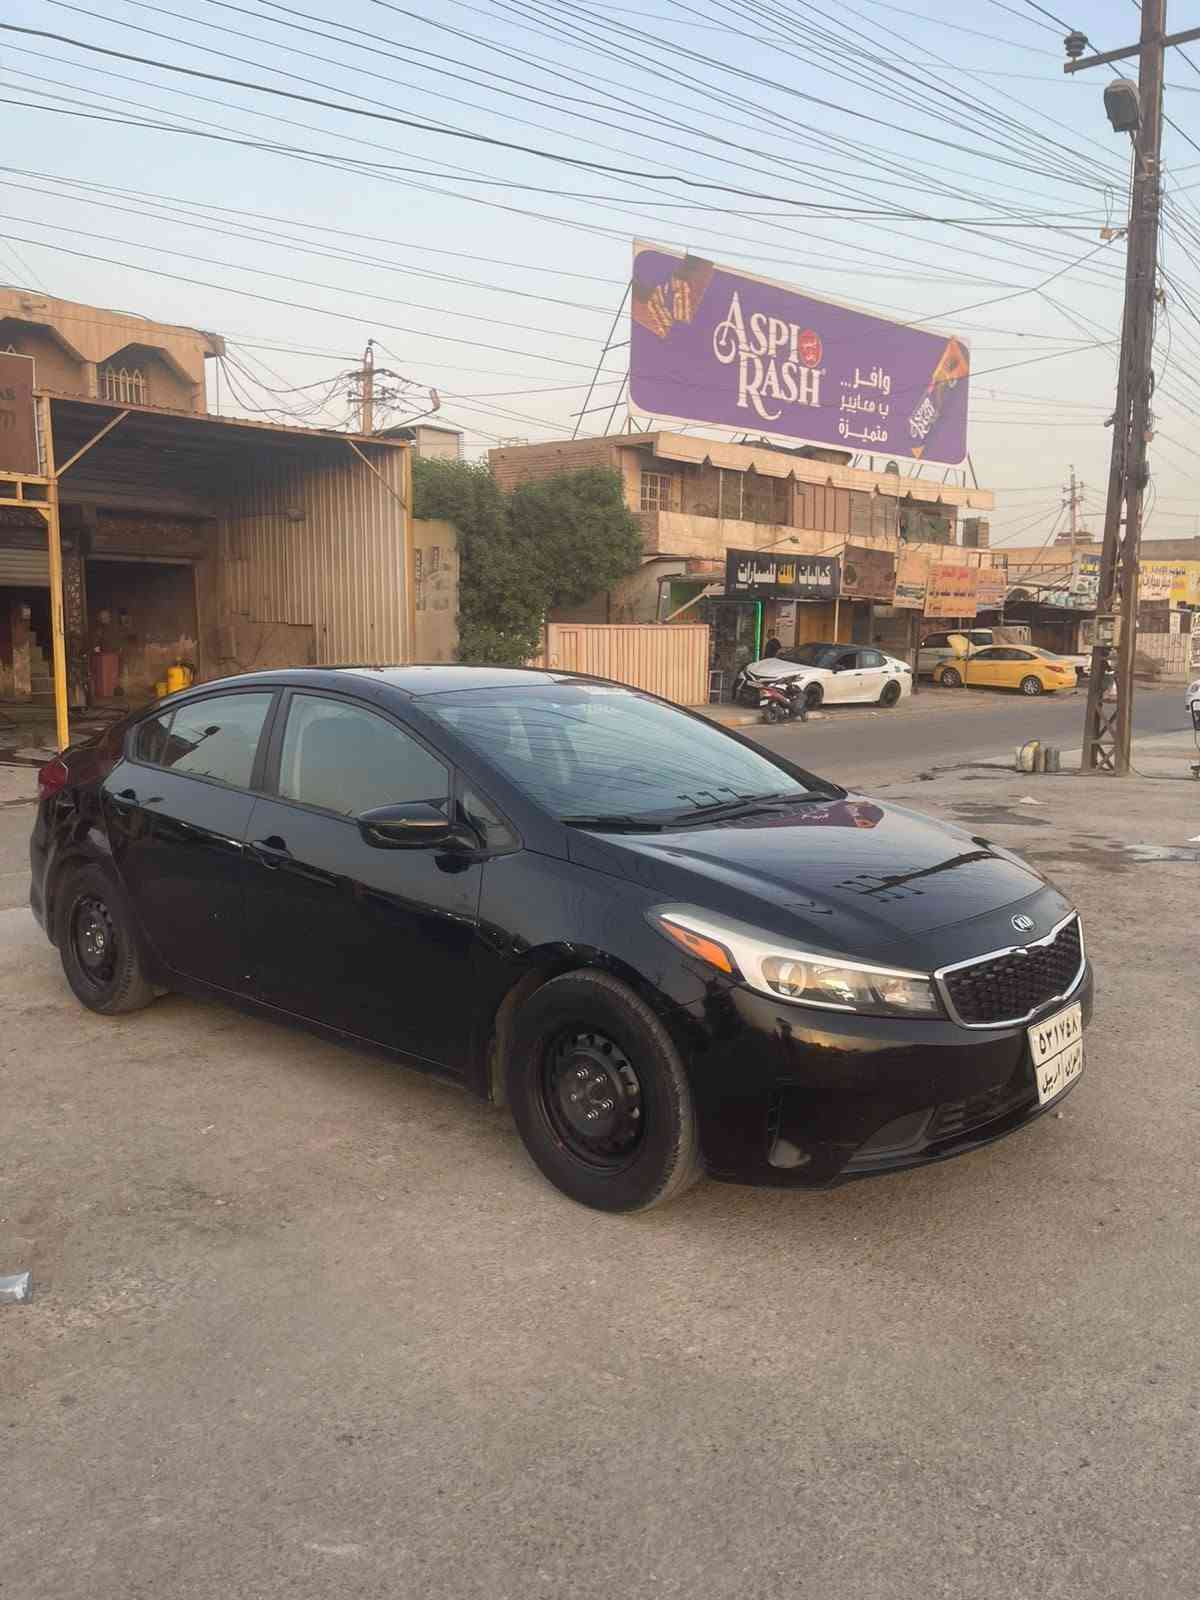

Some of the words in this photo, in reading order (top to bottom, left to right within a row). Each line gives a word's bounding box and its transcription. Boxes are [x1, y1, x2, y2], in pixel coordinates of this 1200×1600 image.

[713, 291, 801, 364] ASPI
[737, 351, 821, 420] RASH
[839, 393, 876, 414] معايير
[838, 418, 888, 442] متميزة
